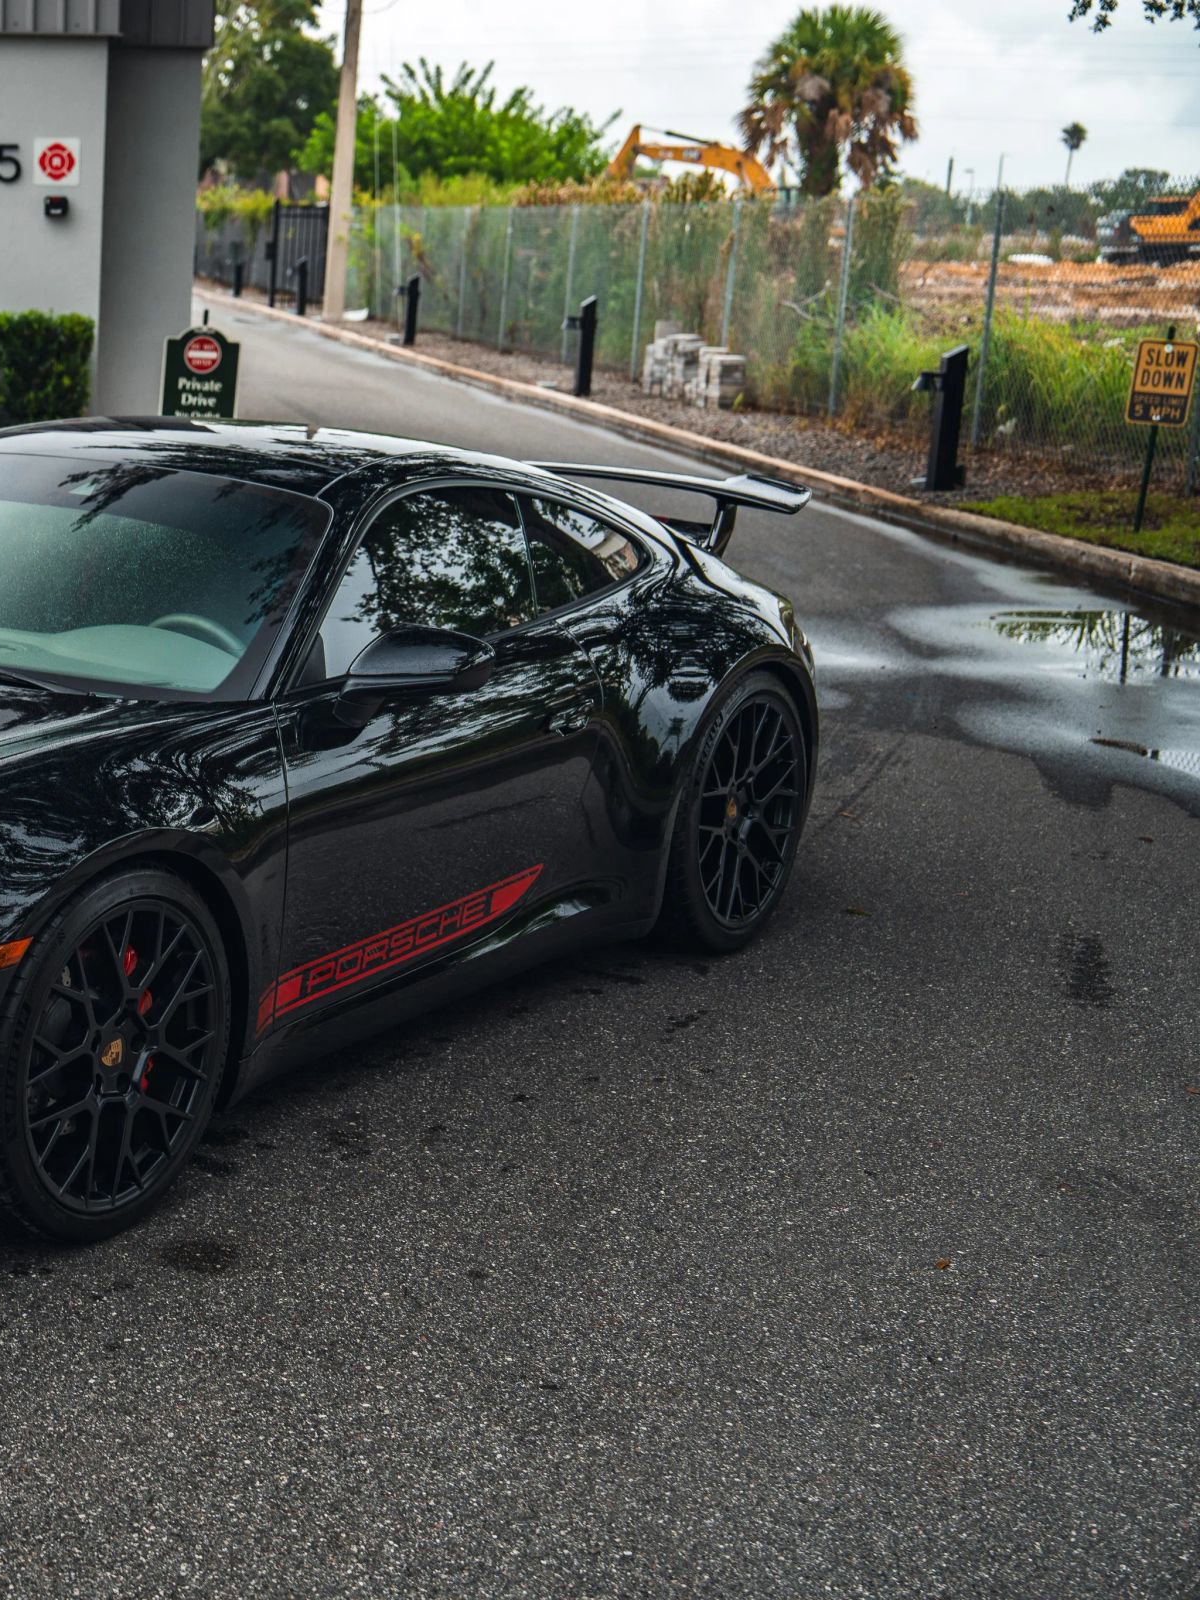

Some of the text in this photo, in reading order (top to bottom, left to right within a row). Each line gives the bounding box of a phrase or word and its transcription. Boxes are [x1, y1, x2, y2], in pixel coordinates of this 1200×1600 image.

[1145, 347, 1189, 368] SLOW
[177, 377, 222, 392] Private
[1140, 368, 1186, 389] DOWN
[181, 393, 217, 407] Drive
[1134, 403, 1181, 419] 5 MPH
[307, 896, 487, 993] PORSCHE
